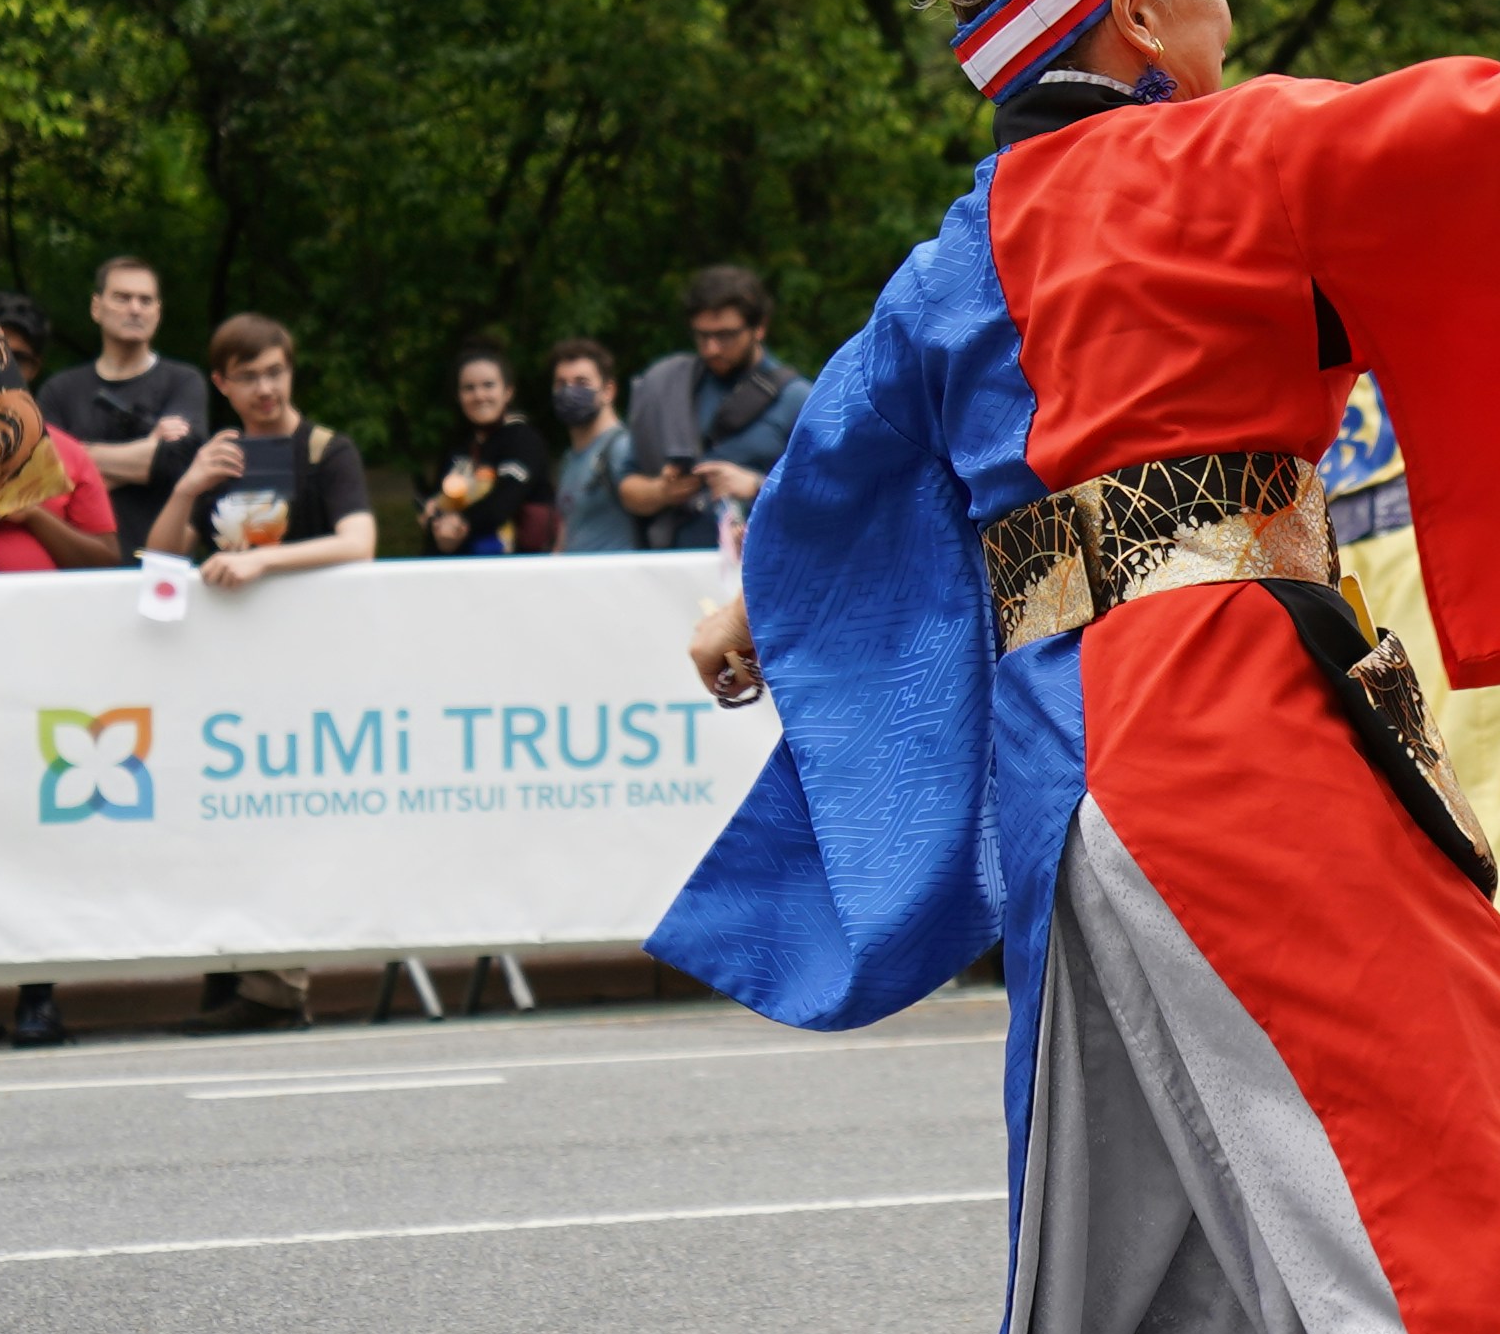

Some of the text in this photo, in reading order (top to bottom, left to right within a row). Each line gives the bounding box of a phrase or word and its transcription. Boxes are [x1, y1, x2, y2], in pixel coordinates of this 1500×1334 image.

[201, 700, 714, 780] SuMi TRUST
[200, 778, 715, 821] SUMITOMO MITSUI TRUST BANK
